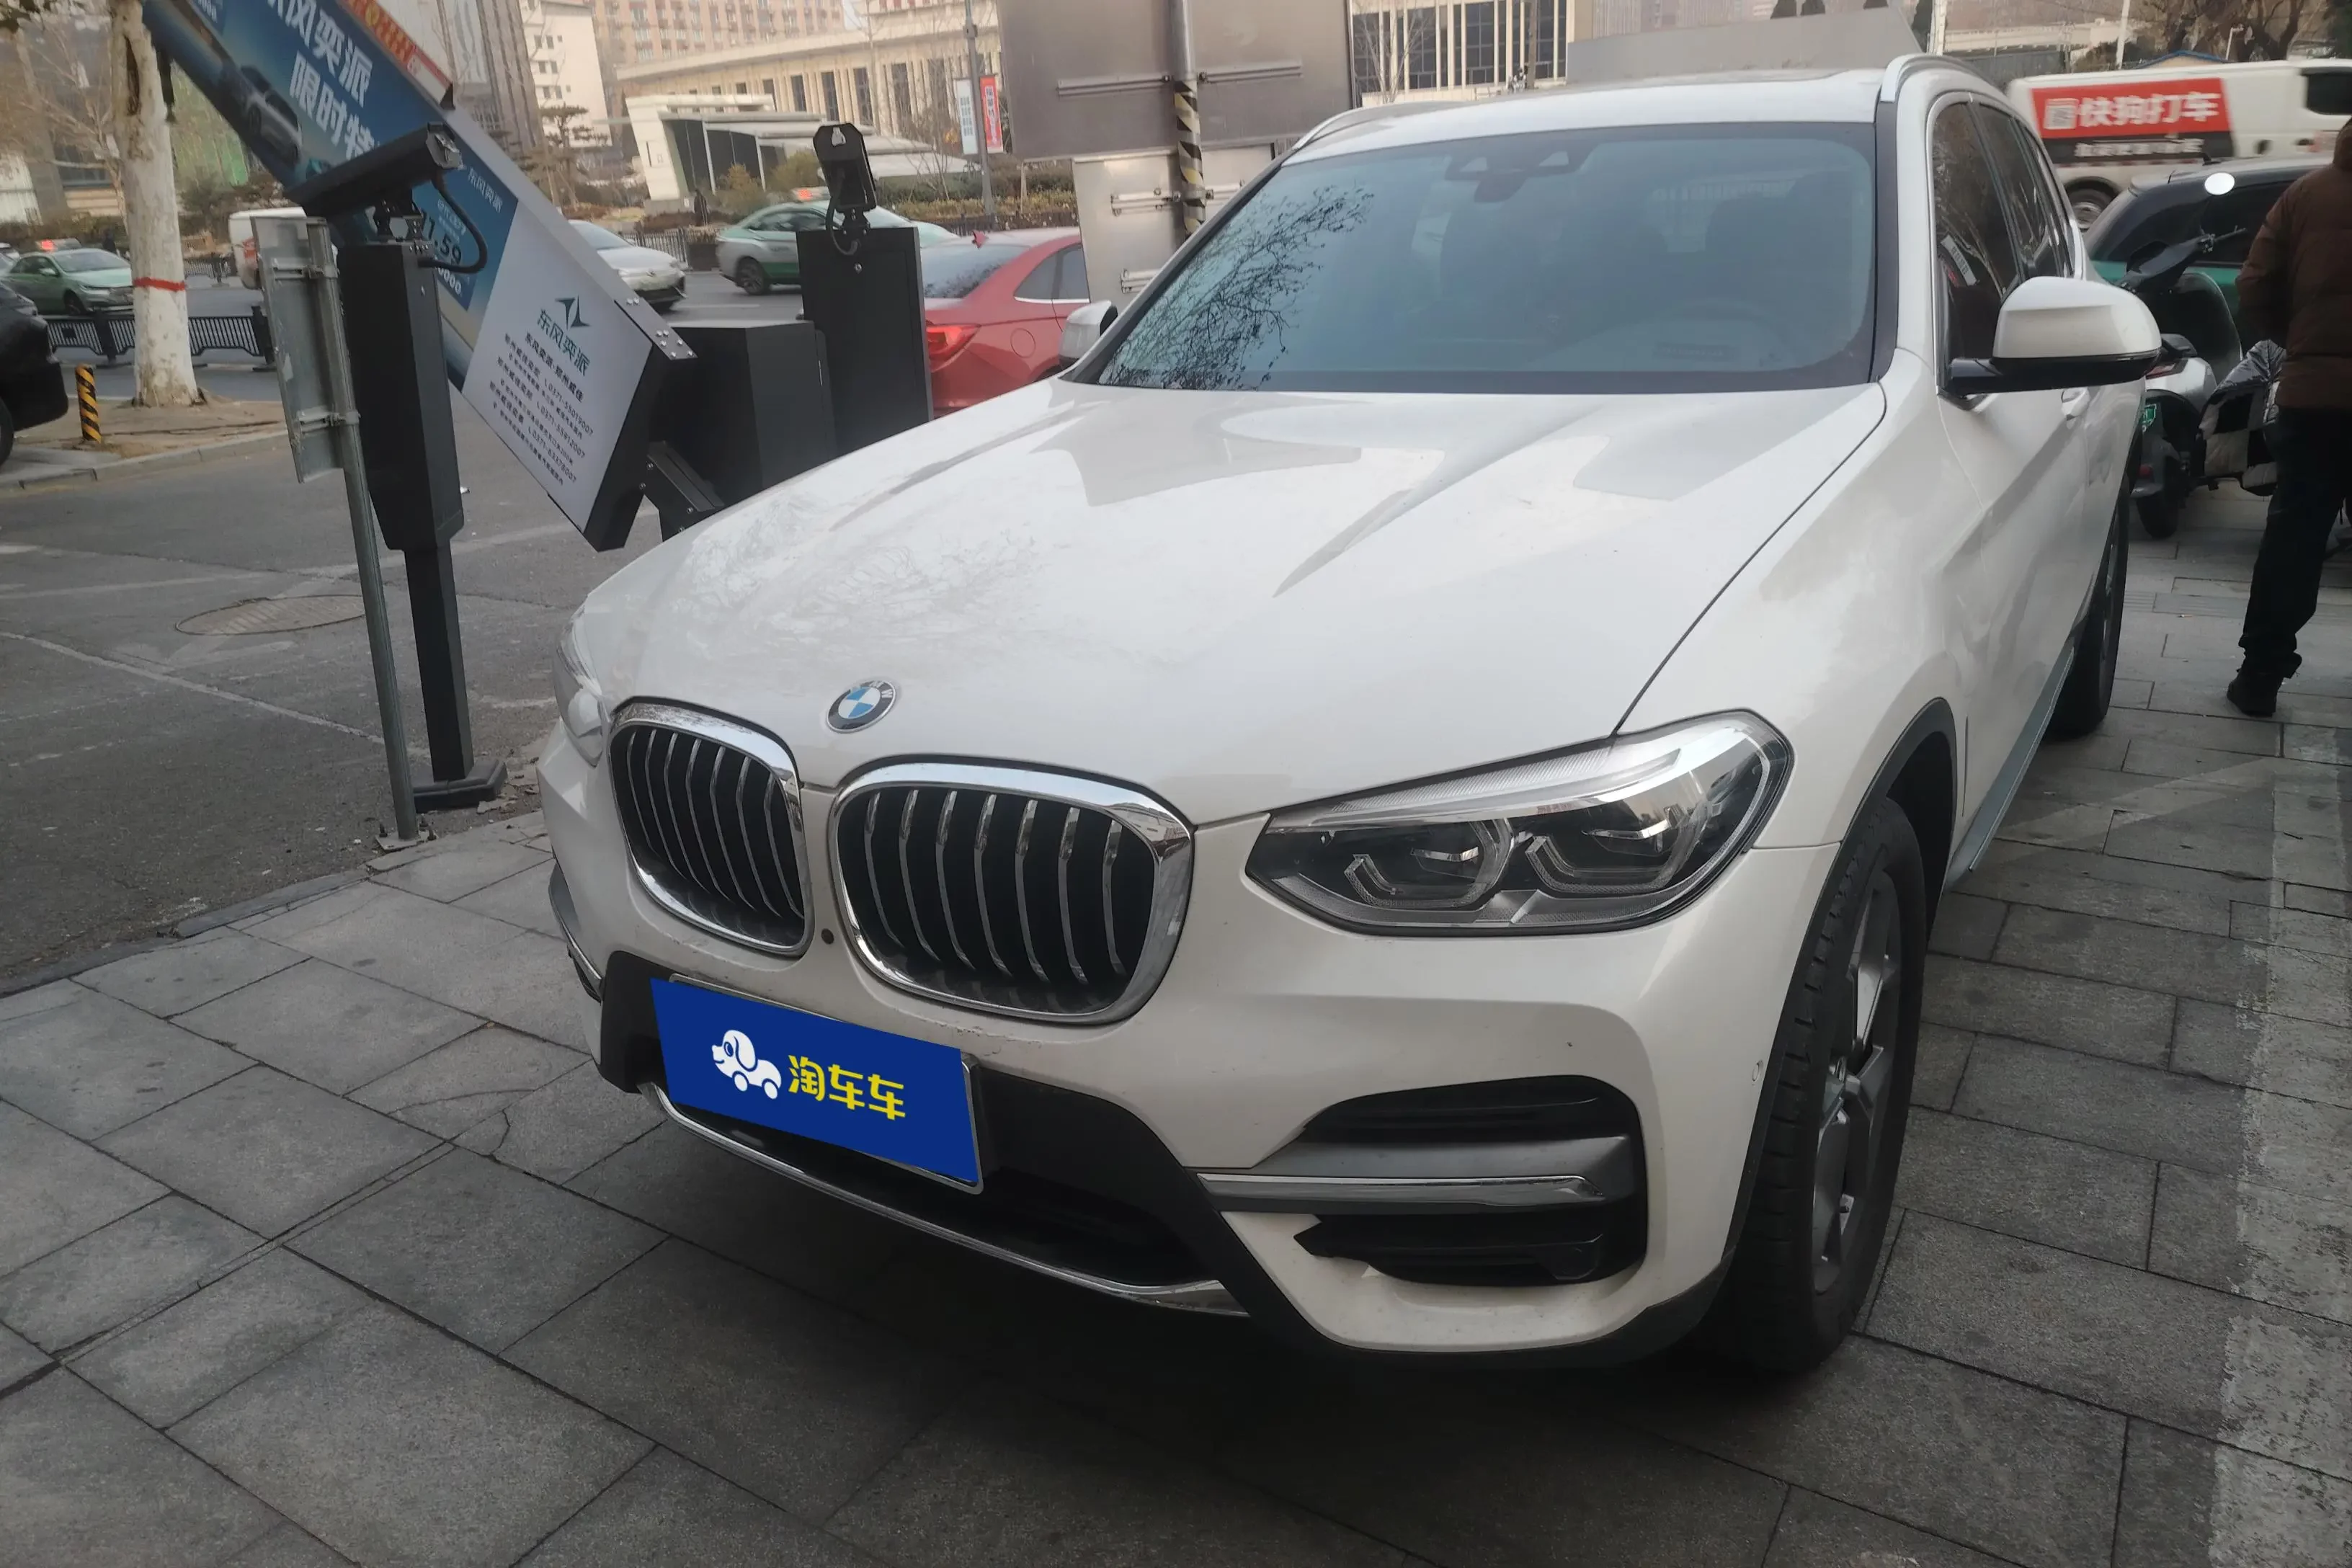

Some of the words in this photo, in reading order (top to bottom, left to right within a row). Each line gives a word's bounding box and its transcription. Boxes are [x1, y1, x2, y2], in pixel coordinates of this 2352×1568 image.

[267, 0, 373, 108] 风奕派
[289, 50, 379, 161] 限时特
[2079, 91, 2222, 128] 快狗打车
[536, 308, 591, 377] 东风奕派
